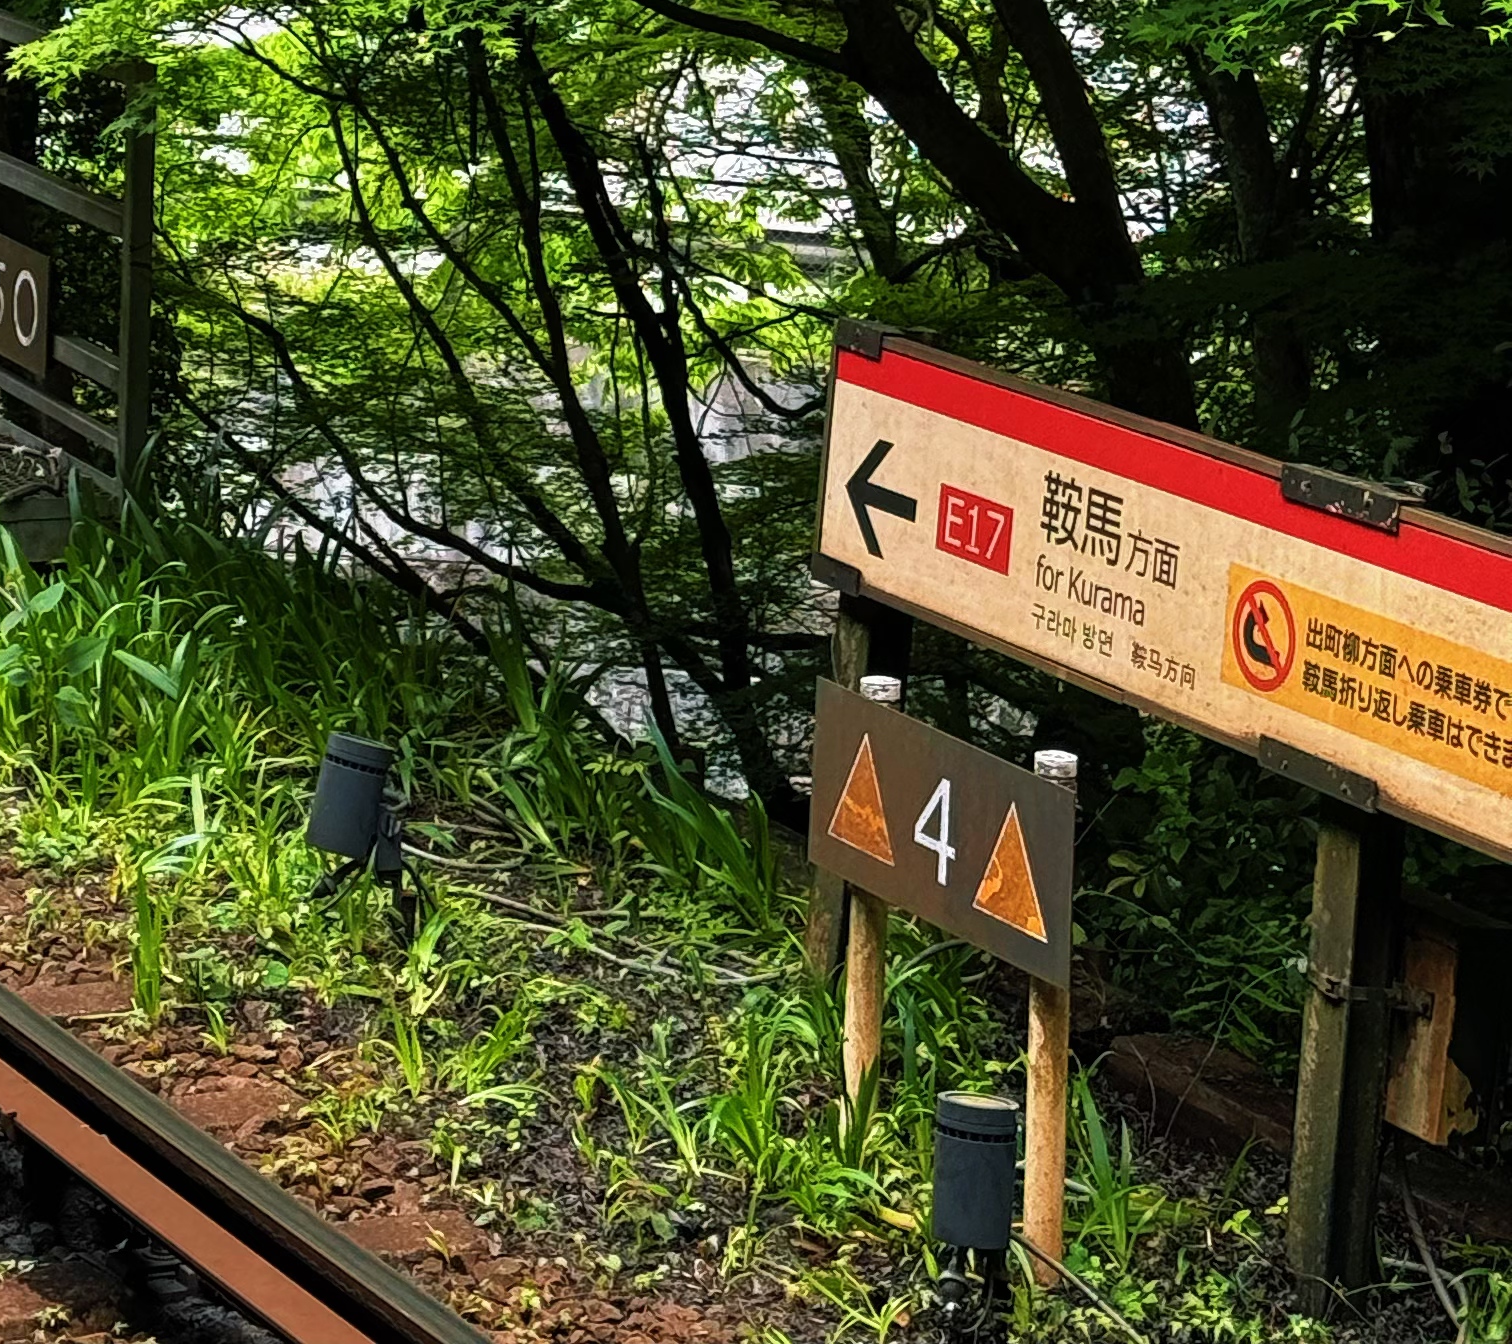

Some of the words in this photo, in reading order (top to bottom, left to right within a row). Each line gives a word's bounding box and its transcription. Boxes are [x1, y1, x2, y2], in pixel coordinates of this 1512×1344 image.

[944, 494, 1006, 560] E17
[1035, 554, 1065, 594] for
[1068, 566, 1146, 628] Kurama
[1031, 602, 1077, 643] 구라마
[1082, 622, 1114, 658] 방면
[1131, 640, 1197, 691] 鞍马方向
[914, 778, 956, 886] 4
